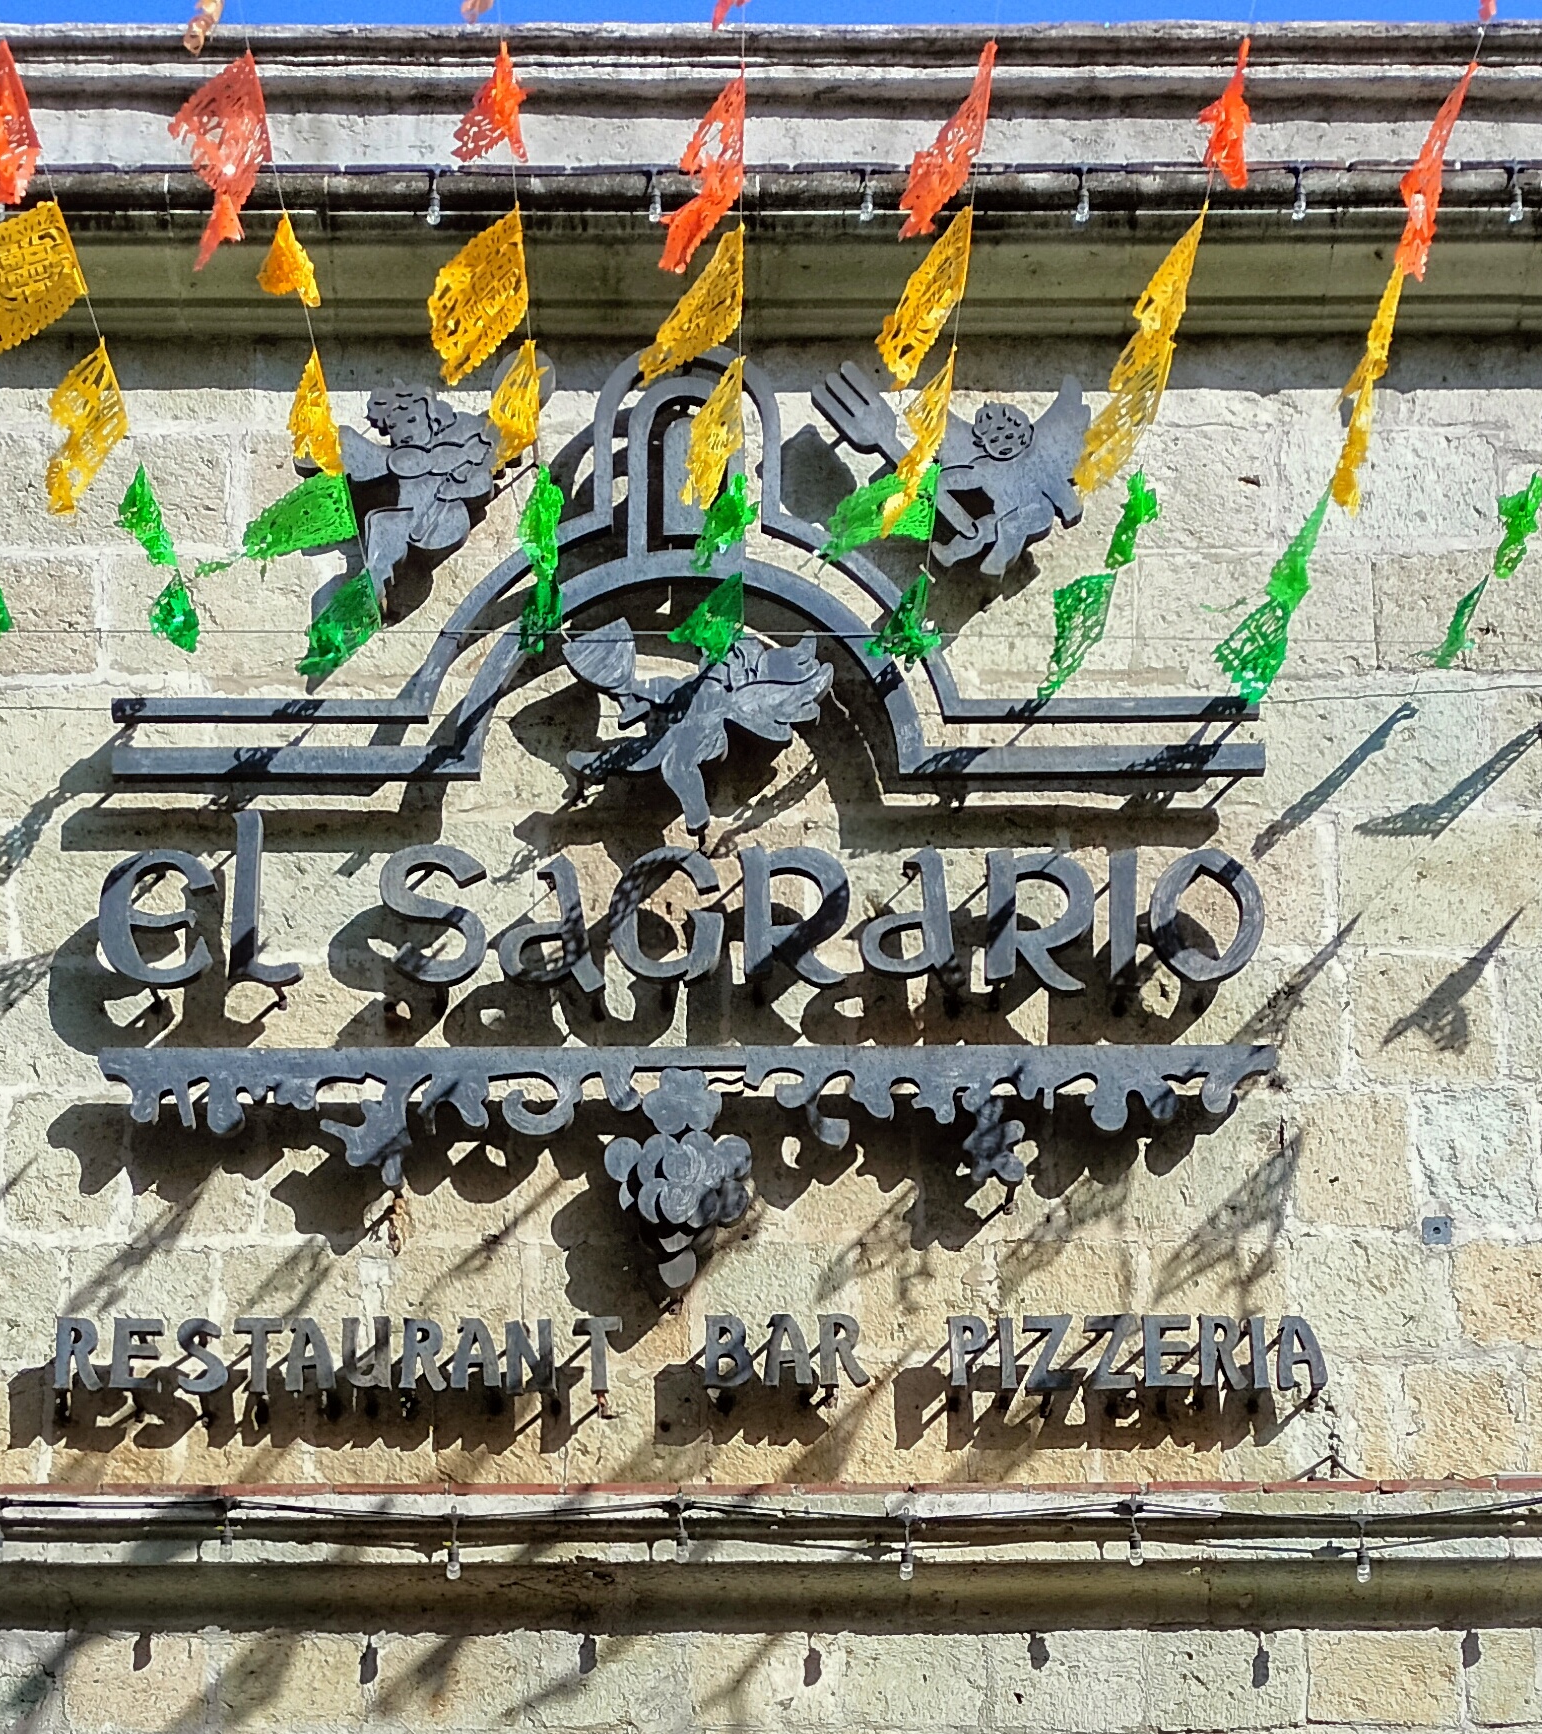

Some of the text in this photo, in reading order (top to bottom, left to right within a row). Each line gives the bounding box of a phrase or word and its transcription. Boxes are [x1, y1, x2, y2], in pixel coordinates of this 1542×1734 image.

[53, 1312, 1328, 1394] RESTAURANT BAR PIZZERIA
